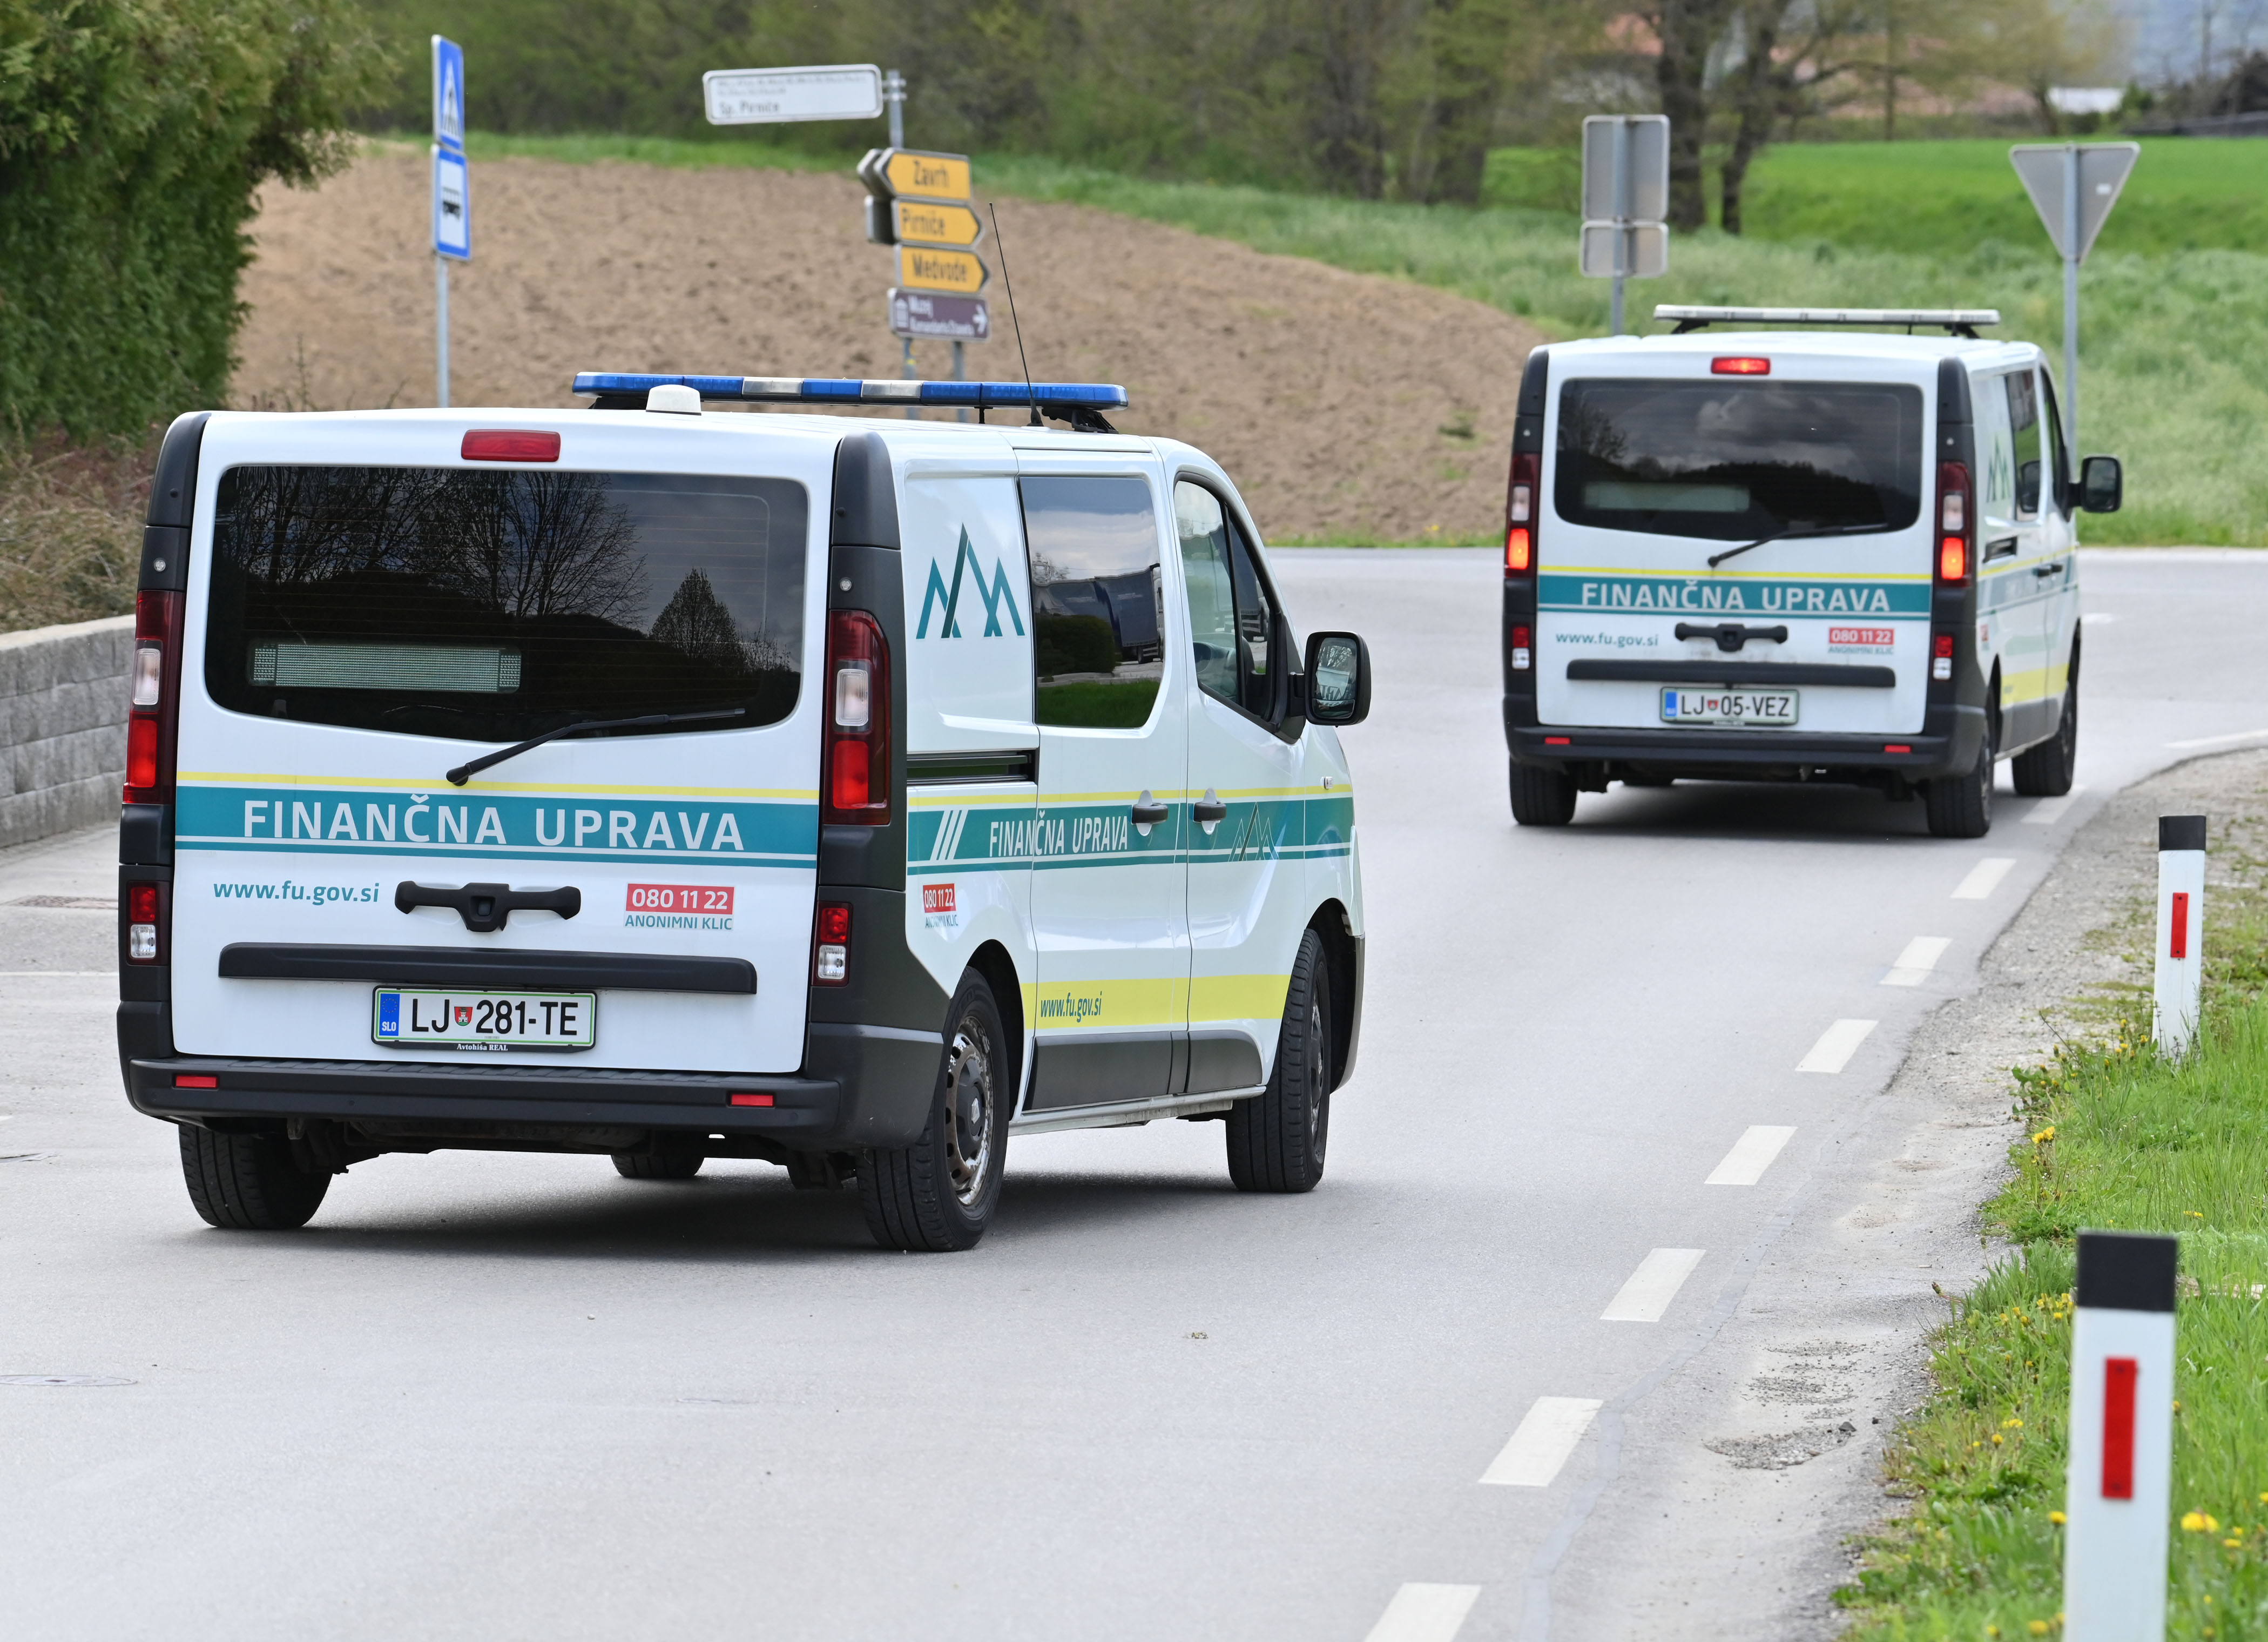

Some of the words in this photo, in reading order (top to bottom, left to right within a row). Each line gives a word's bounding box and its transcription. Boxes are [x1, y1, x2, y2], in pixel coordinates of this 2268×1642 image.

[913, 160, 950, 188] Zavrh
[912, 254, 968, 282] Medvode
[1582, 580, 1745, 609] FINANČNA
[1761, 587, 1890, 612] UPRAVA
[1556, 632, 1658, 647] www.fu.gov.si
[1831, 629, 1858, 642] 080
[1860, 630, 1873, 643] 11
[1876, 630, 1891, 643] 22
[1681, 695, 1704, 715] LJ
[1721, 695, 1790, 717] 05-VEZ
[244, 793, 507, 844] FINANČNA
[536, 808, 744, 851] UPRAVA
[989, 810, 1065, 857] FINANČNA
[1072, 816, 1128, 853] UPRAVA
[213, 880, 380, 906] www.fu.gov.si
[632, 889, 674, 908] 080
[680, 890, 698, 909] 11
[704, 891, 728, 910] 22
[924, 889, 937, 909] 080
[937, 889, 944, 907] 11
[945, 888, 954, 907] 22
[624, 914, 698, 928] ANONIMNI
[701, 917, 732, 930] KLIC
[946, 914, 959, 927] KLIC
[411, 998, 450, 1033] LJ
[476, 999, 578, 1035] 281-TE
[1040, 991, 1103, 1023] www.fu.gov.si
[381, 1021, 397, 1032] SLO
[456, 1043, 488, 1051] Avtohiša
[489, 1044, 509, 1052] REAL
